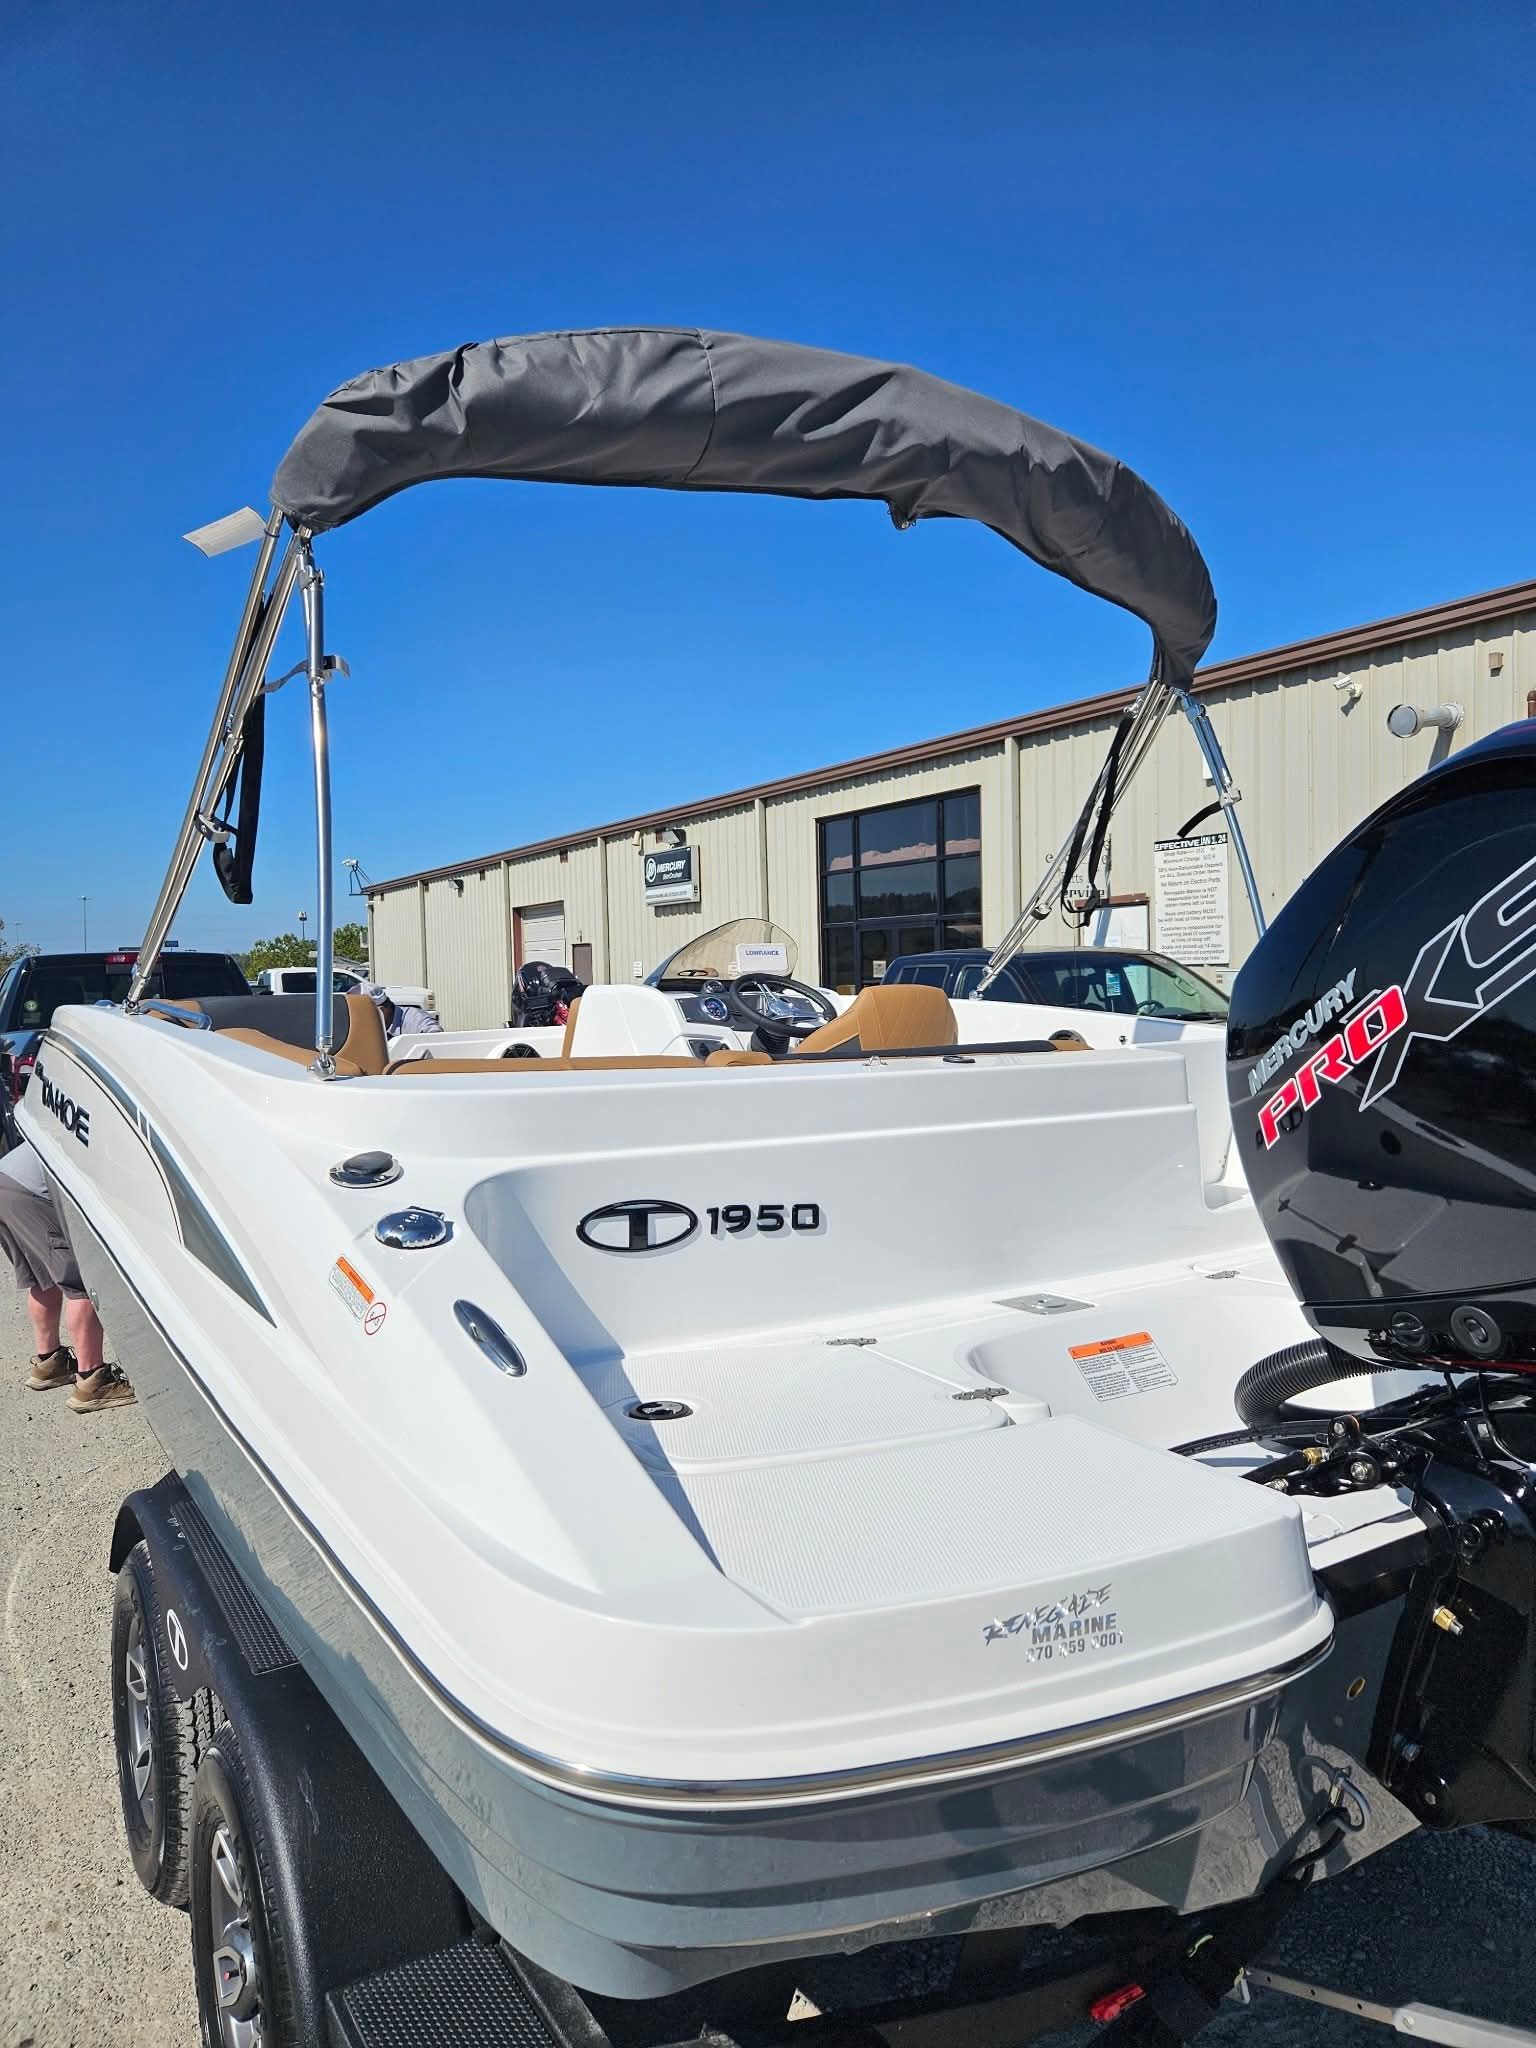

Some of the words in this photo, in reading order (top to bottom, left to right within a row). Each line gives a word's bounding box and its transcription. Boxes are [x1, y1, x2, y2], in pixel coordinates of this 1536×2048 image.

[1154, 839, 1200, 851] EFFECTIVE
[656, 860, 686, 873] MERCURY
[1247, 967, 1357, 1097] MERCURY
[1257, 984, 1409, 1151] PRO
[41, 1074, 90, 1148] TAHOE
[706, 1202, 820, 1235] 1950
[1031, 1612, 1117, 1645] MARINE
